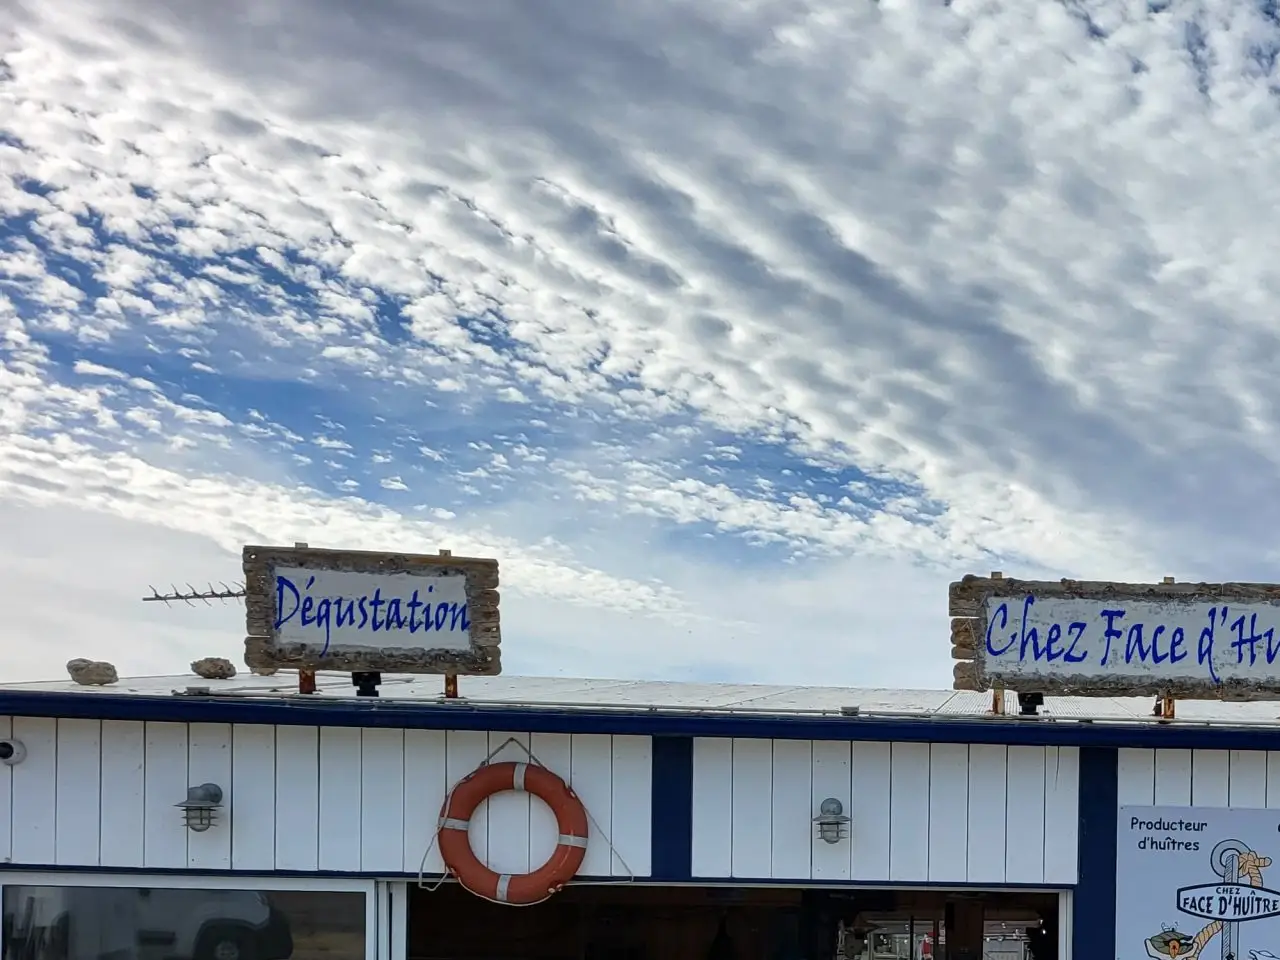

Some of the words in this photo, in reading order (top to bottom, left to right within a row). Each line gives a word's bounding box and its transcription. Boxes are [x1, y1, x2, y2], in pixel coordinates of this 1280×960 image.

[274, 575, 472, 658] Dégustation
[985, 594, 1089, 664] Chez
[1100, 608, 1189, 667] Face
[1130, 816, 1208, 832] Producteur
[1137, 835, 1200, 851] d'huîtres
[1215, 887, 1241, 895] CHEZ
[1183, 896, 1214, 914] FACE
[1218, 890, 1280, 916] D'HUÎTRE
